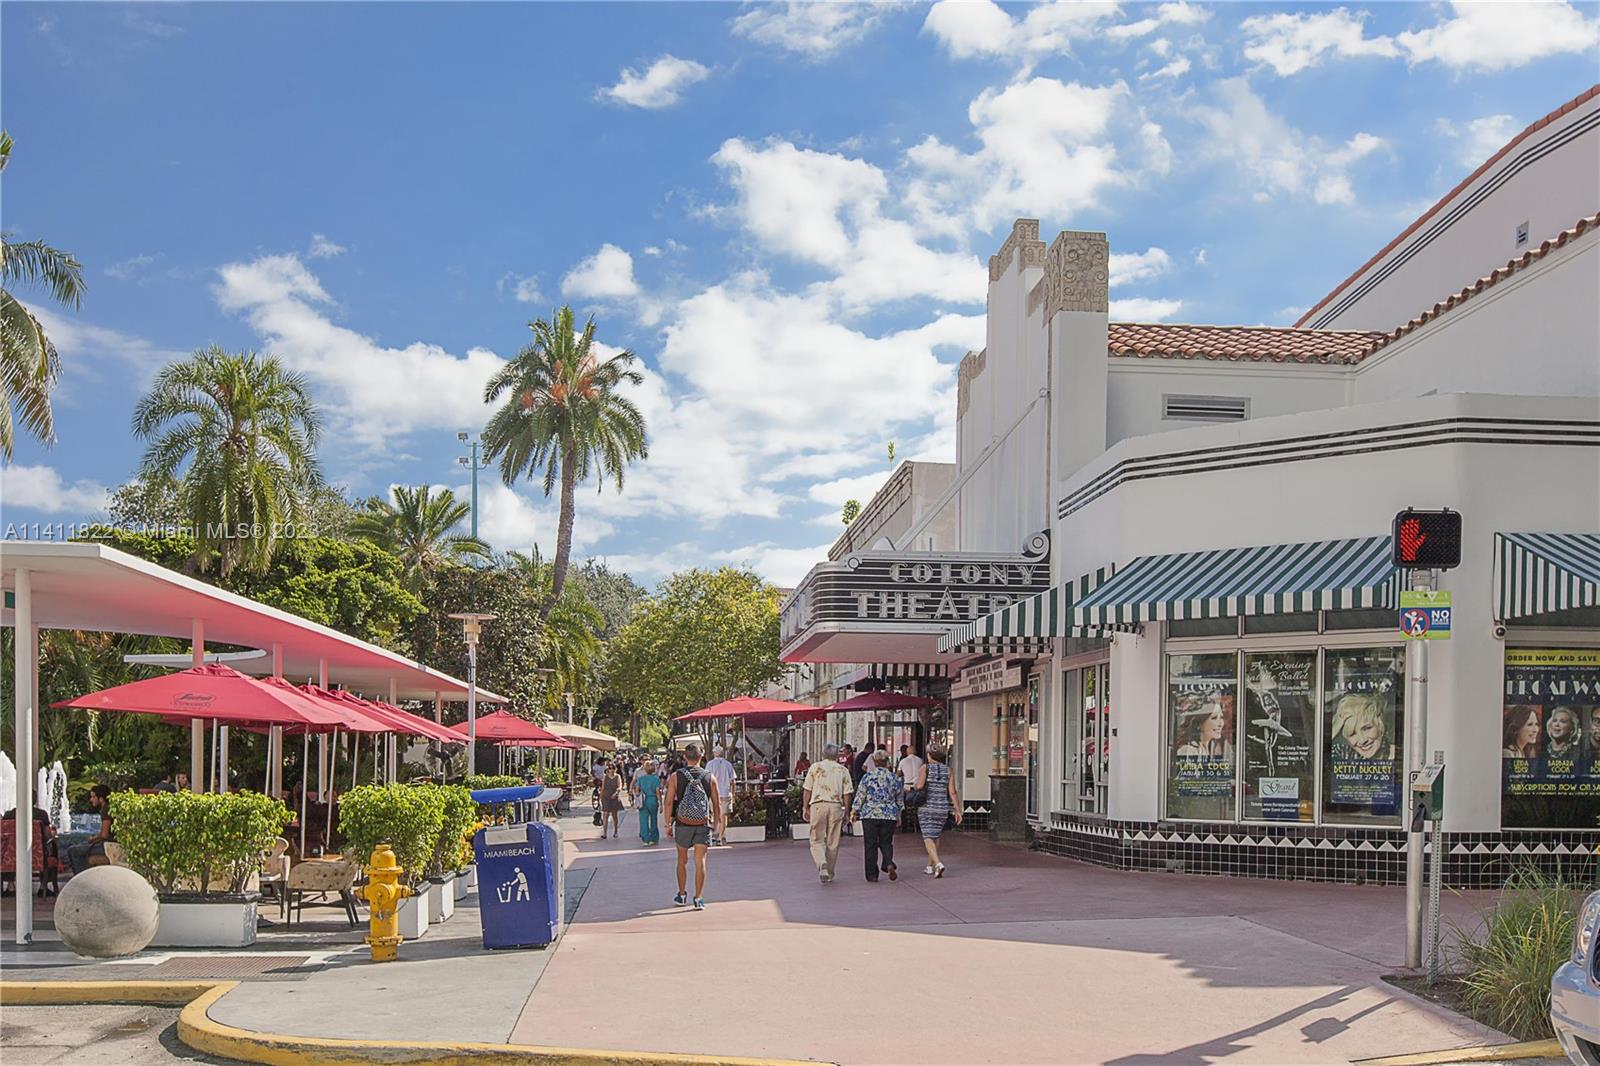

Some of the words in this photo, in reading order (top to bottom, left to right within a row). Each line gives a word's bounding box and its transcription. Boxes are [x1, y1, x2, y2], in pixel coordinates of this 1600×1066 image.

[889, 562, 1037, 585] COLONY
[851, 585, 1038, 619] THEATR
[1431, 610, 1449, 619] NO
[1270, 660, 1311, 672] Evening
[1278, 670, 1309, 681] Ballet
[1333, 765, 1357, 773] BETTY
[1359, 765, 1392, 773] BUCKLEY
[1510, 783, 1557, 791] SUBSCRIPTIONS
[1558, 783, 1578, 791] NOW
[1579, 783, 1591, 791] ON
